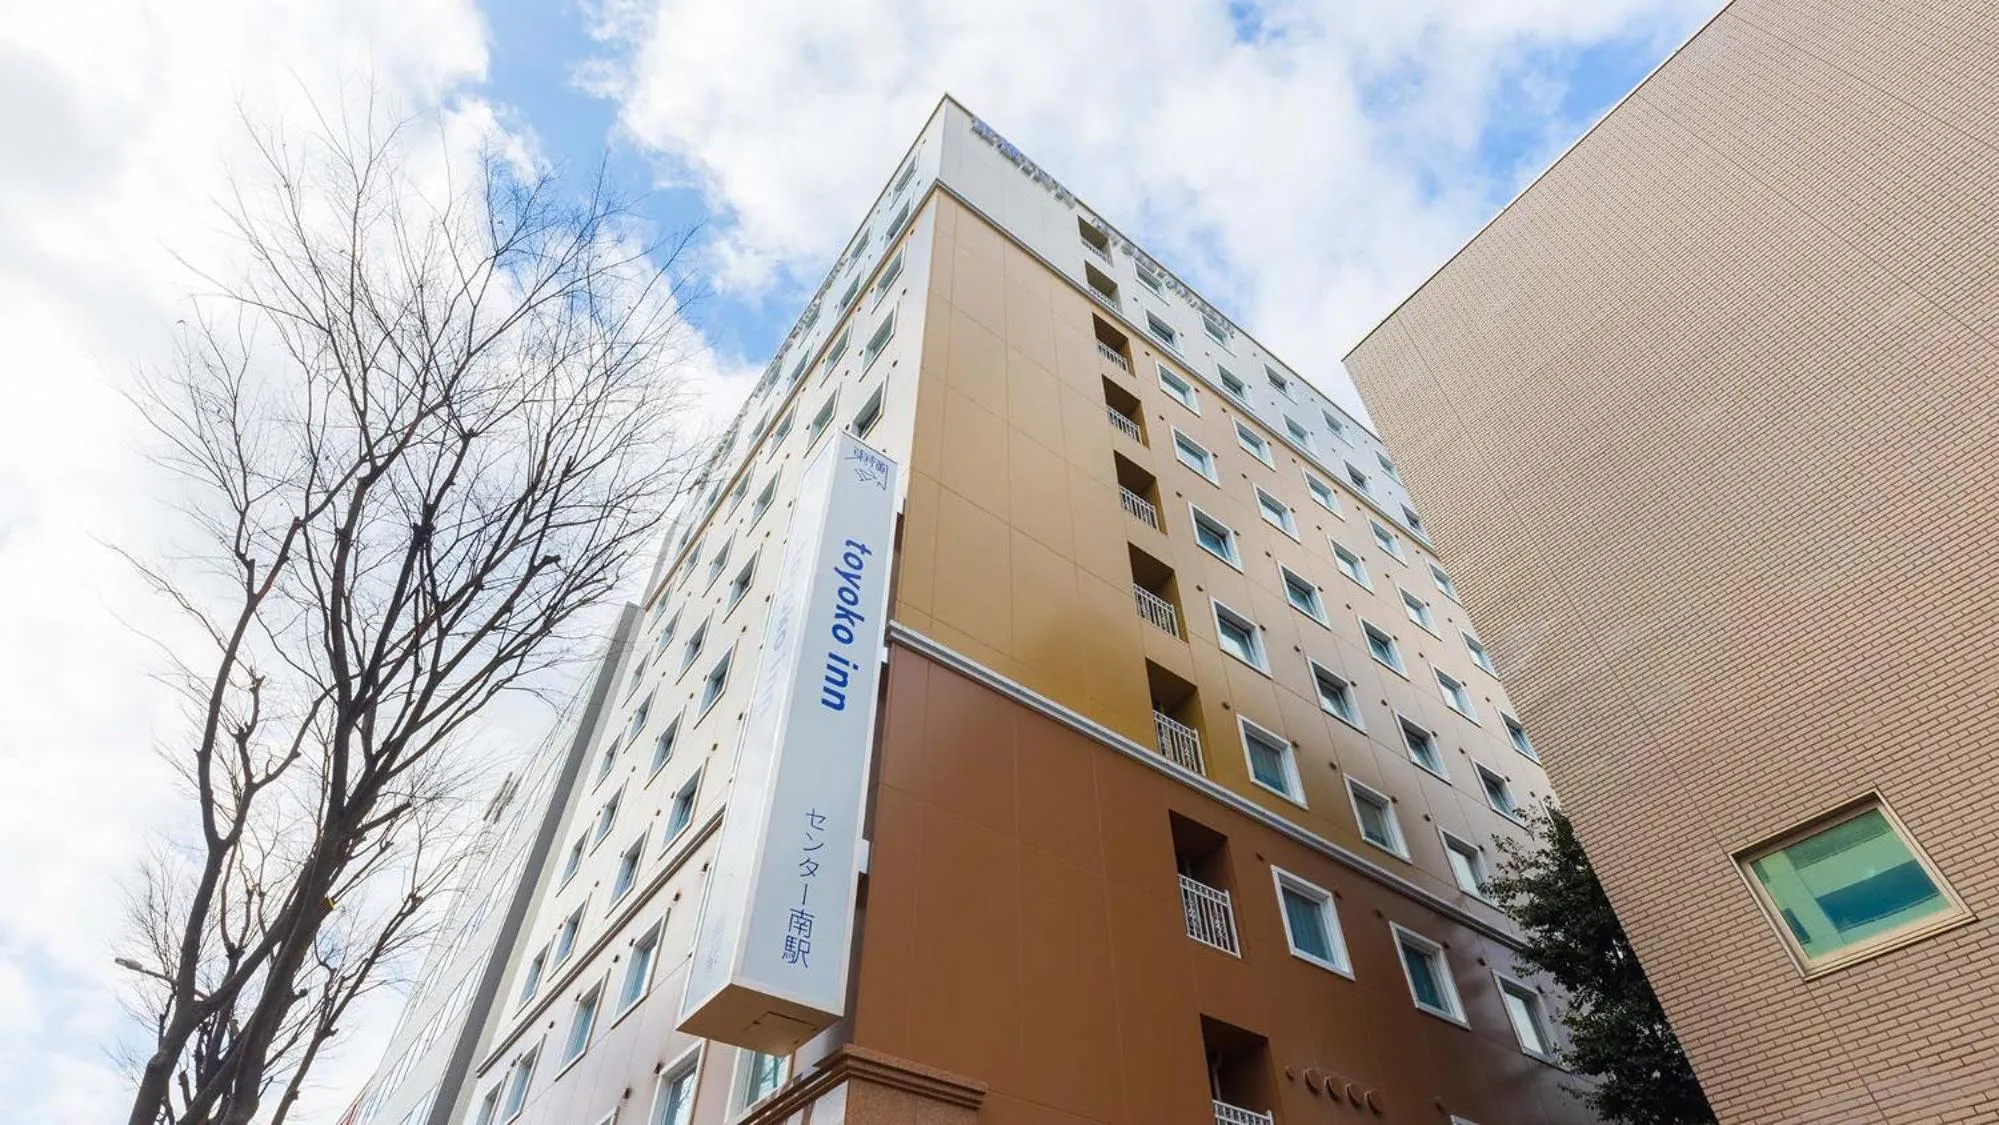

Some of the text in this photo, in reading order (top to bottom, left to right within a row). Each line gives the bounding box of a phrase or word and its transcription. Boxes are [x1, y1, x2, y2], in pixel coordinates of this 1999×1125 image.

[821, 539, 872, 711] toyoko inn
[781, 807, 826, 968] センター南駅
